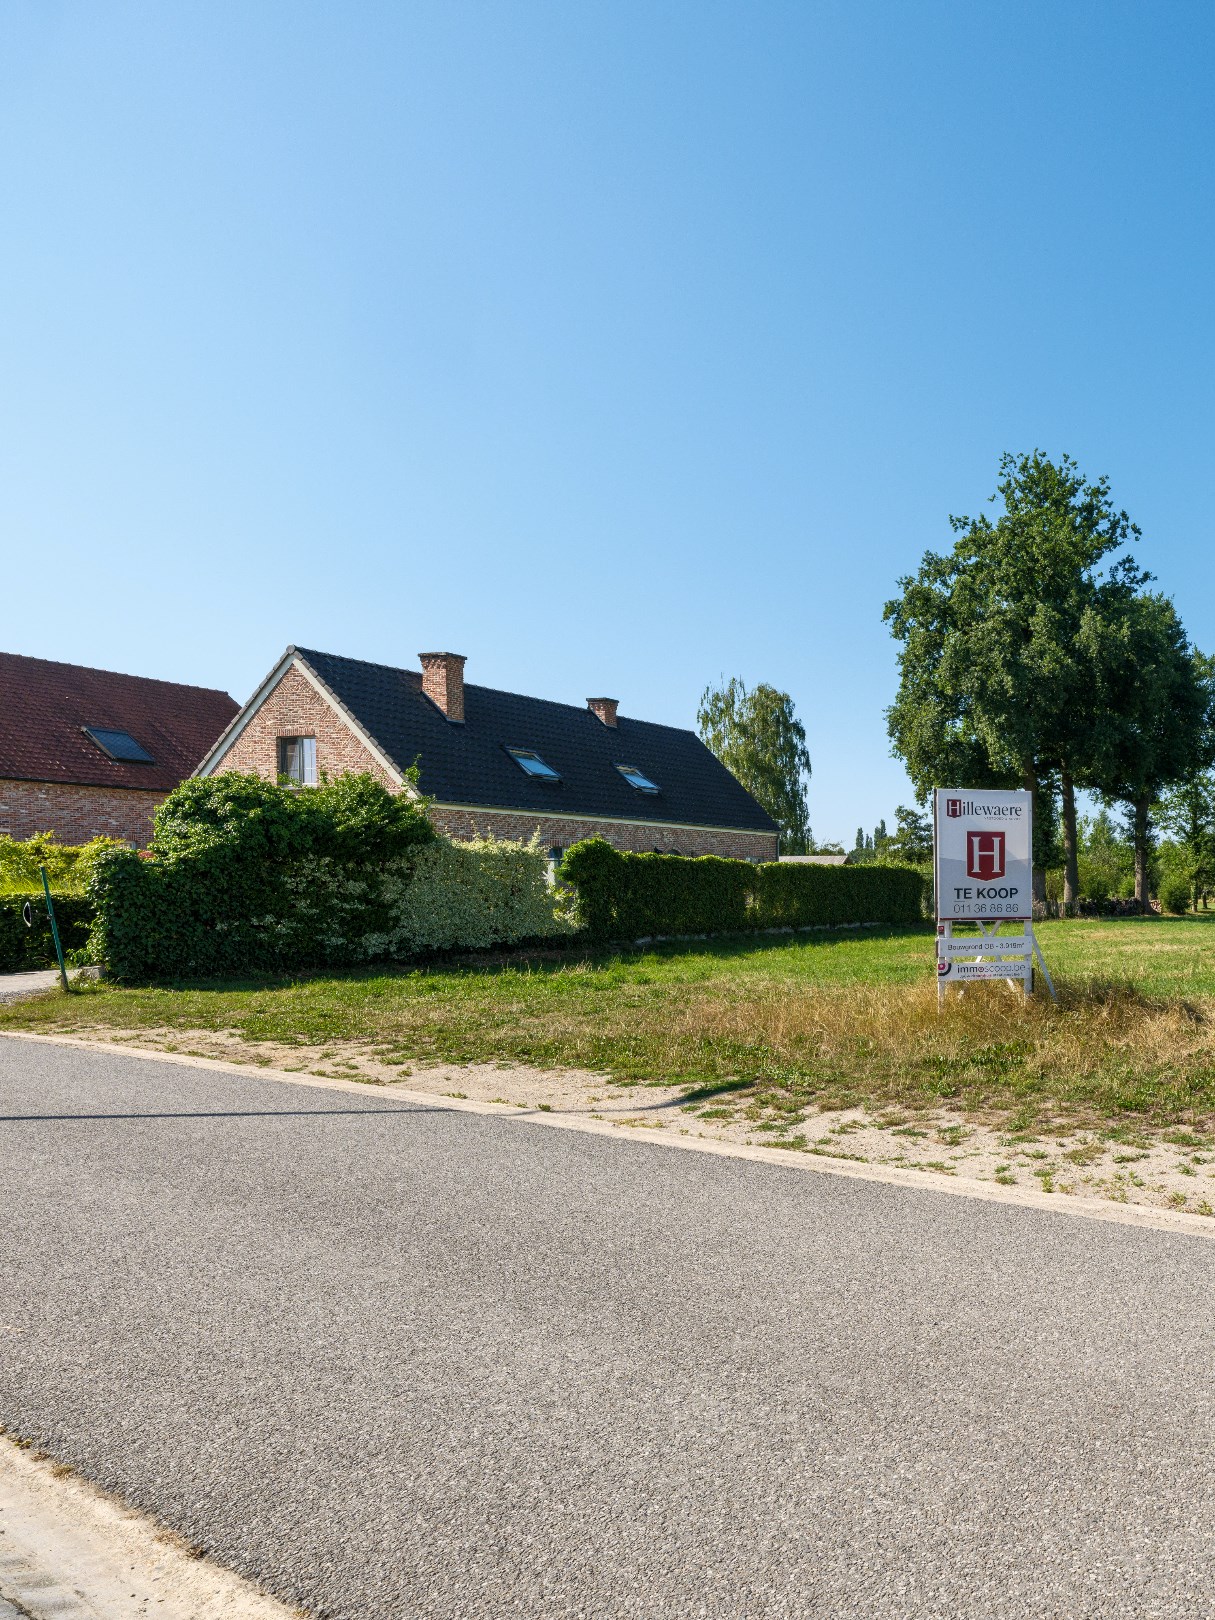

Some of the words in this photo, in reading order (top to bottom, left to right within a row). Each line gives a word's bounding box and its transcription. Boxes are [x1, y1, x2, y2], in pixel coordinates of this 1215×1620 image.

[947, 801, 1022, 817] Hillewaere
[971, 836, 1002, 873] H
[954, 888, 972, 899] TE
[977, 888, 1018, 899] KOOP
[953, 904, 971, 913] 011
[974, 903, 987, 913] 36
[989, 903, 1003, 913] 86
[1005, 903, 1019, 913] 86
